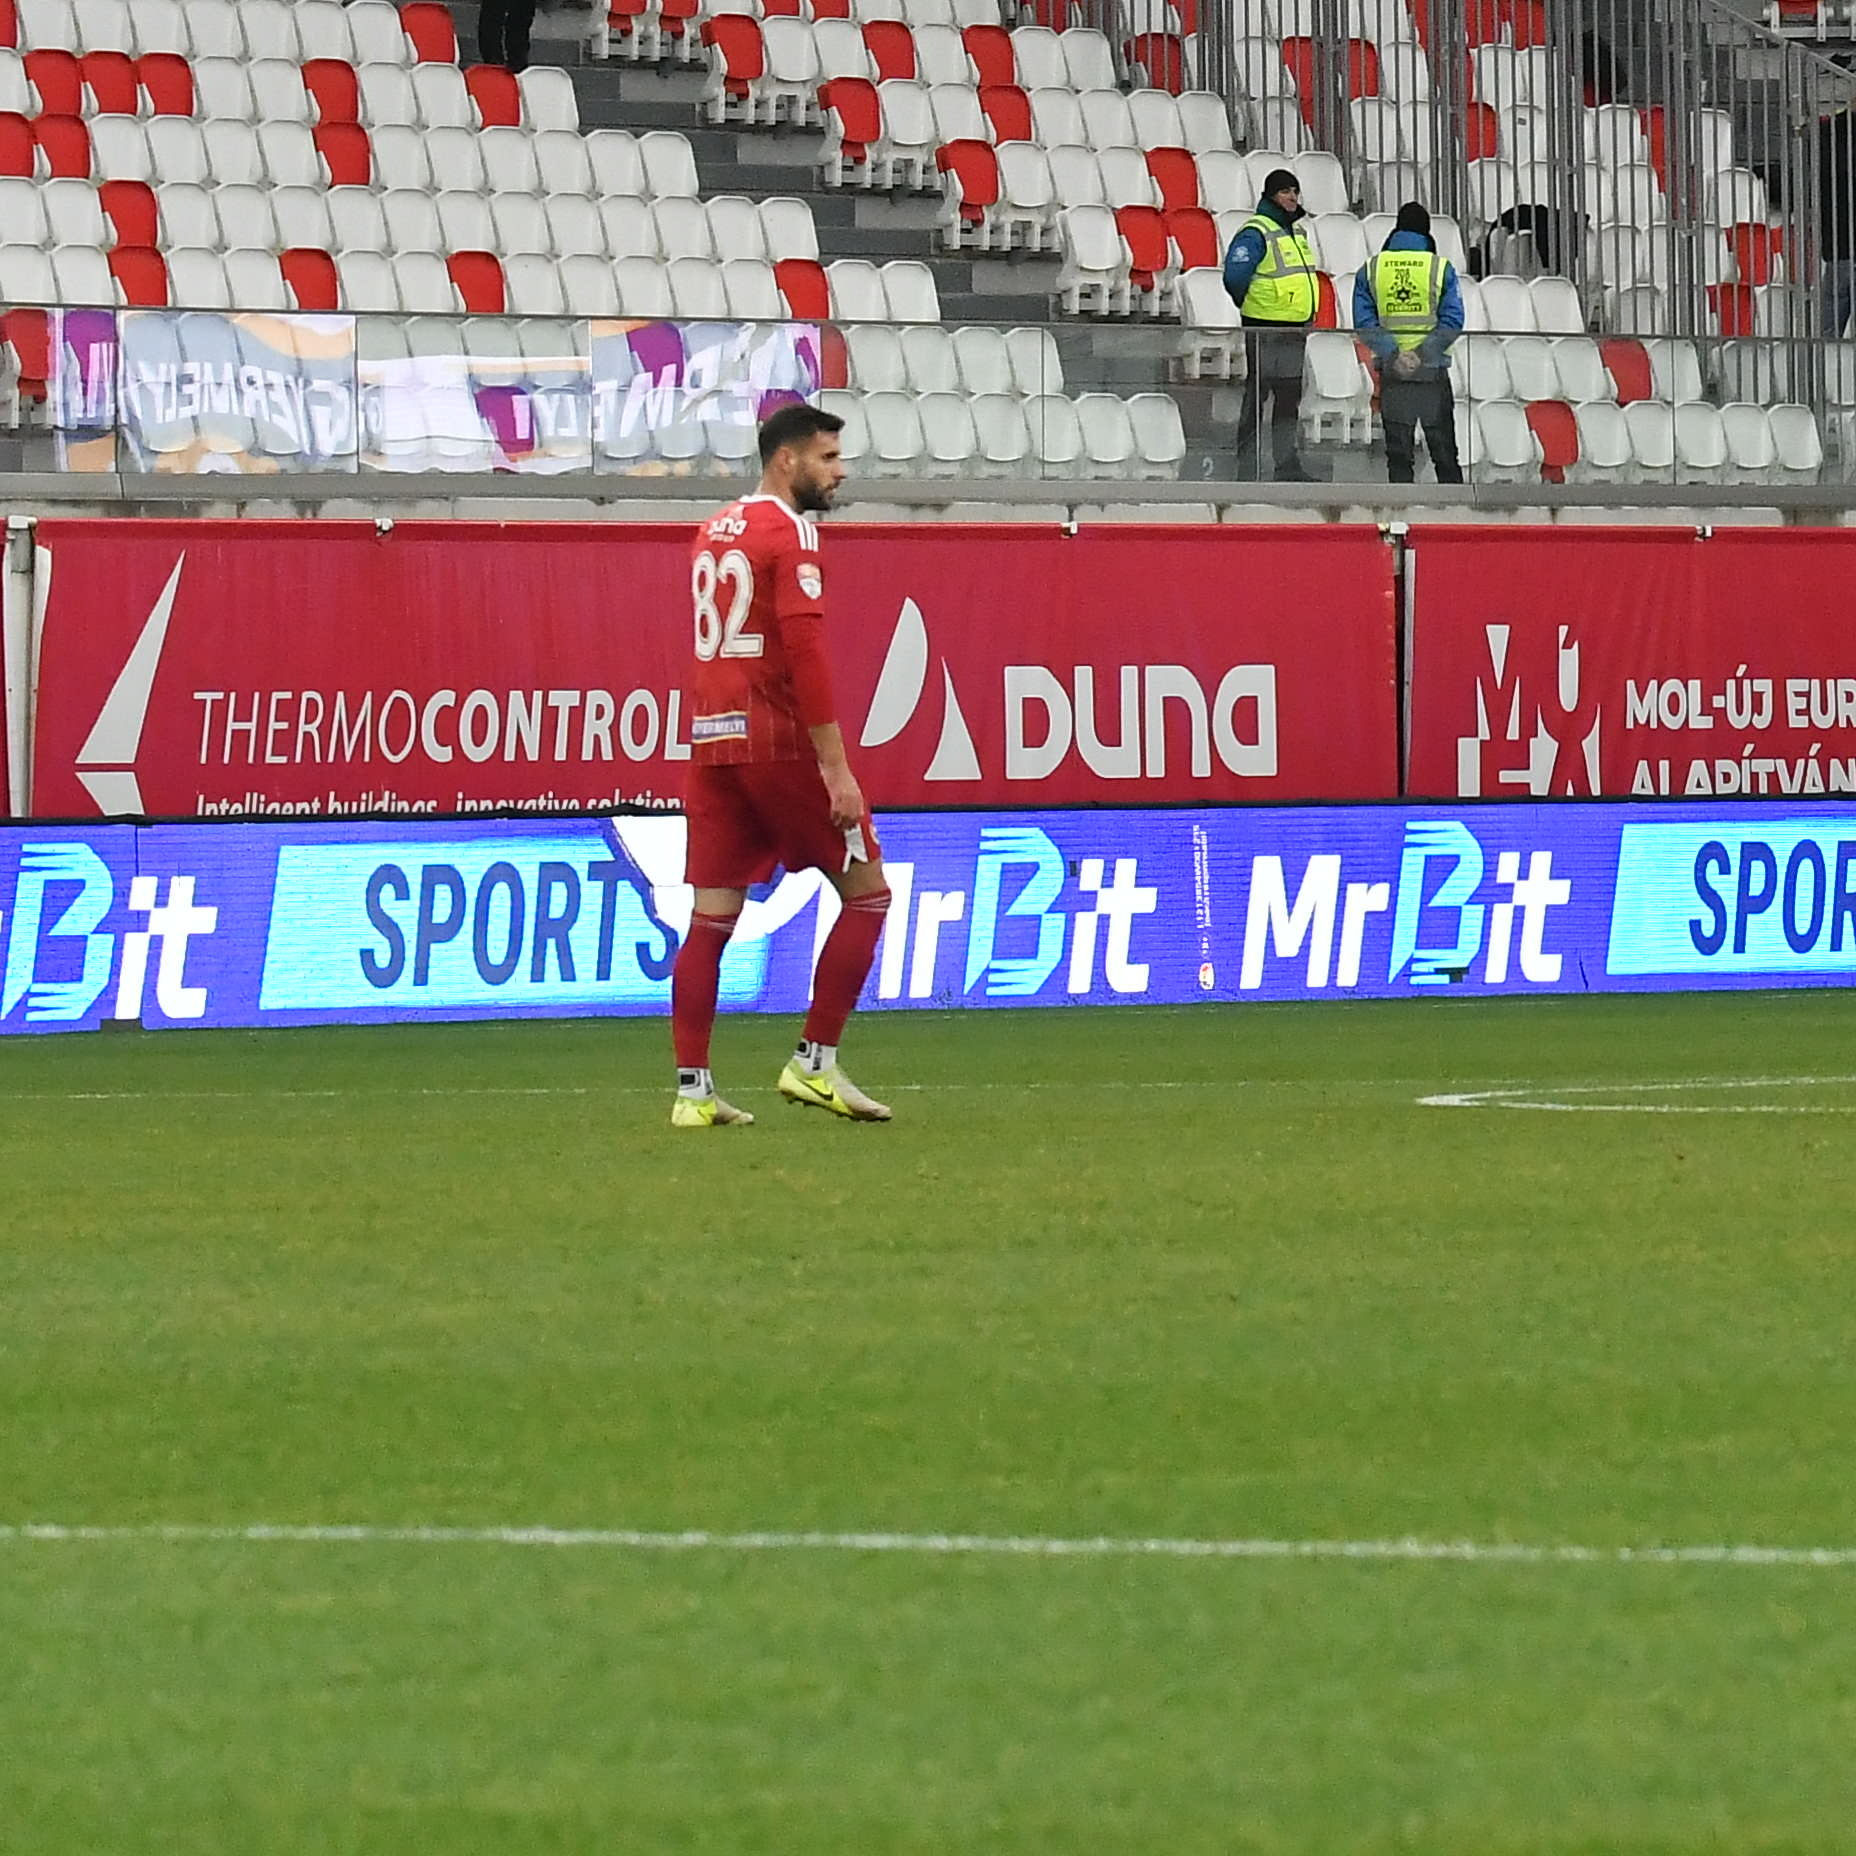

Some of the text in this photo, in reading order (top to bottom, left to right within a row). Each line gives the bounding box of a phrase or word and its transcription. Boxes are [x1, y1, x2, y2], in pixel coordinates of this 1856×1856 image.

[691, 548, 765, 663] 82
[192, 687, 692, 766] THERMOCONTROL
[1625, 663, 1772, 732] MOL-ÚJ
[585, 788, 687, 813] solution
[358, 859, 681, 991] SPORTS
[1239, 819, 1572, 991] MrBit
